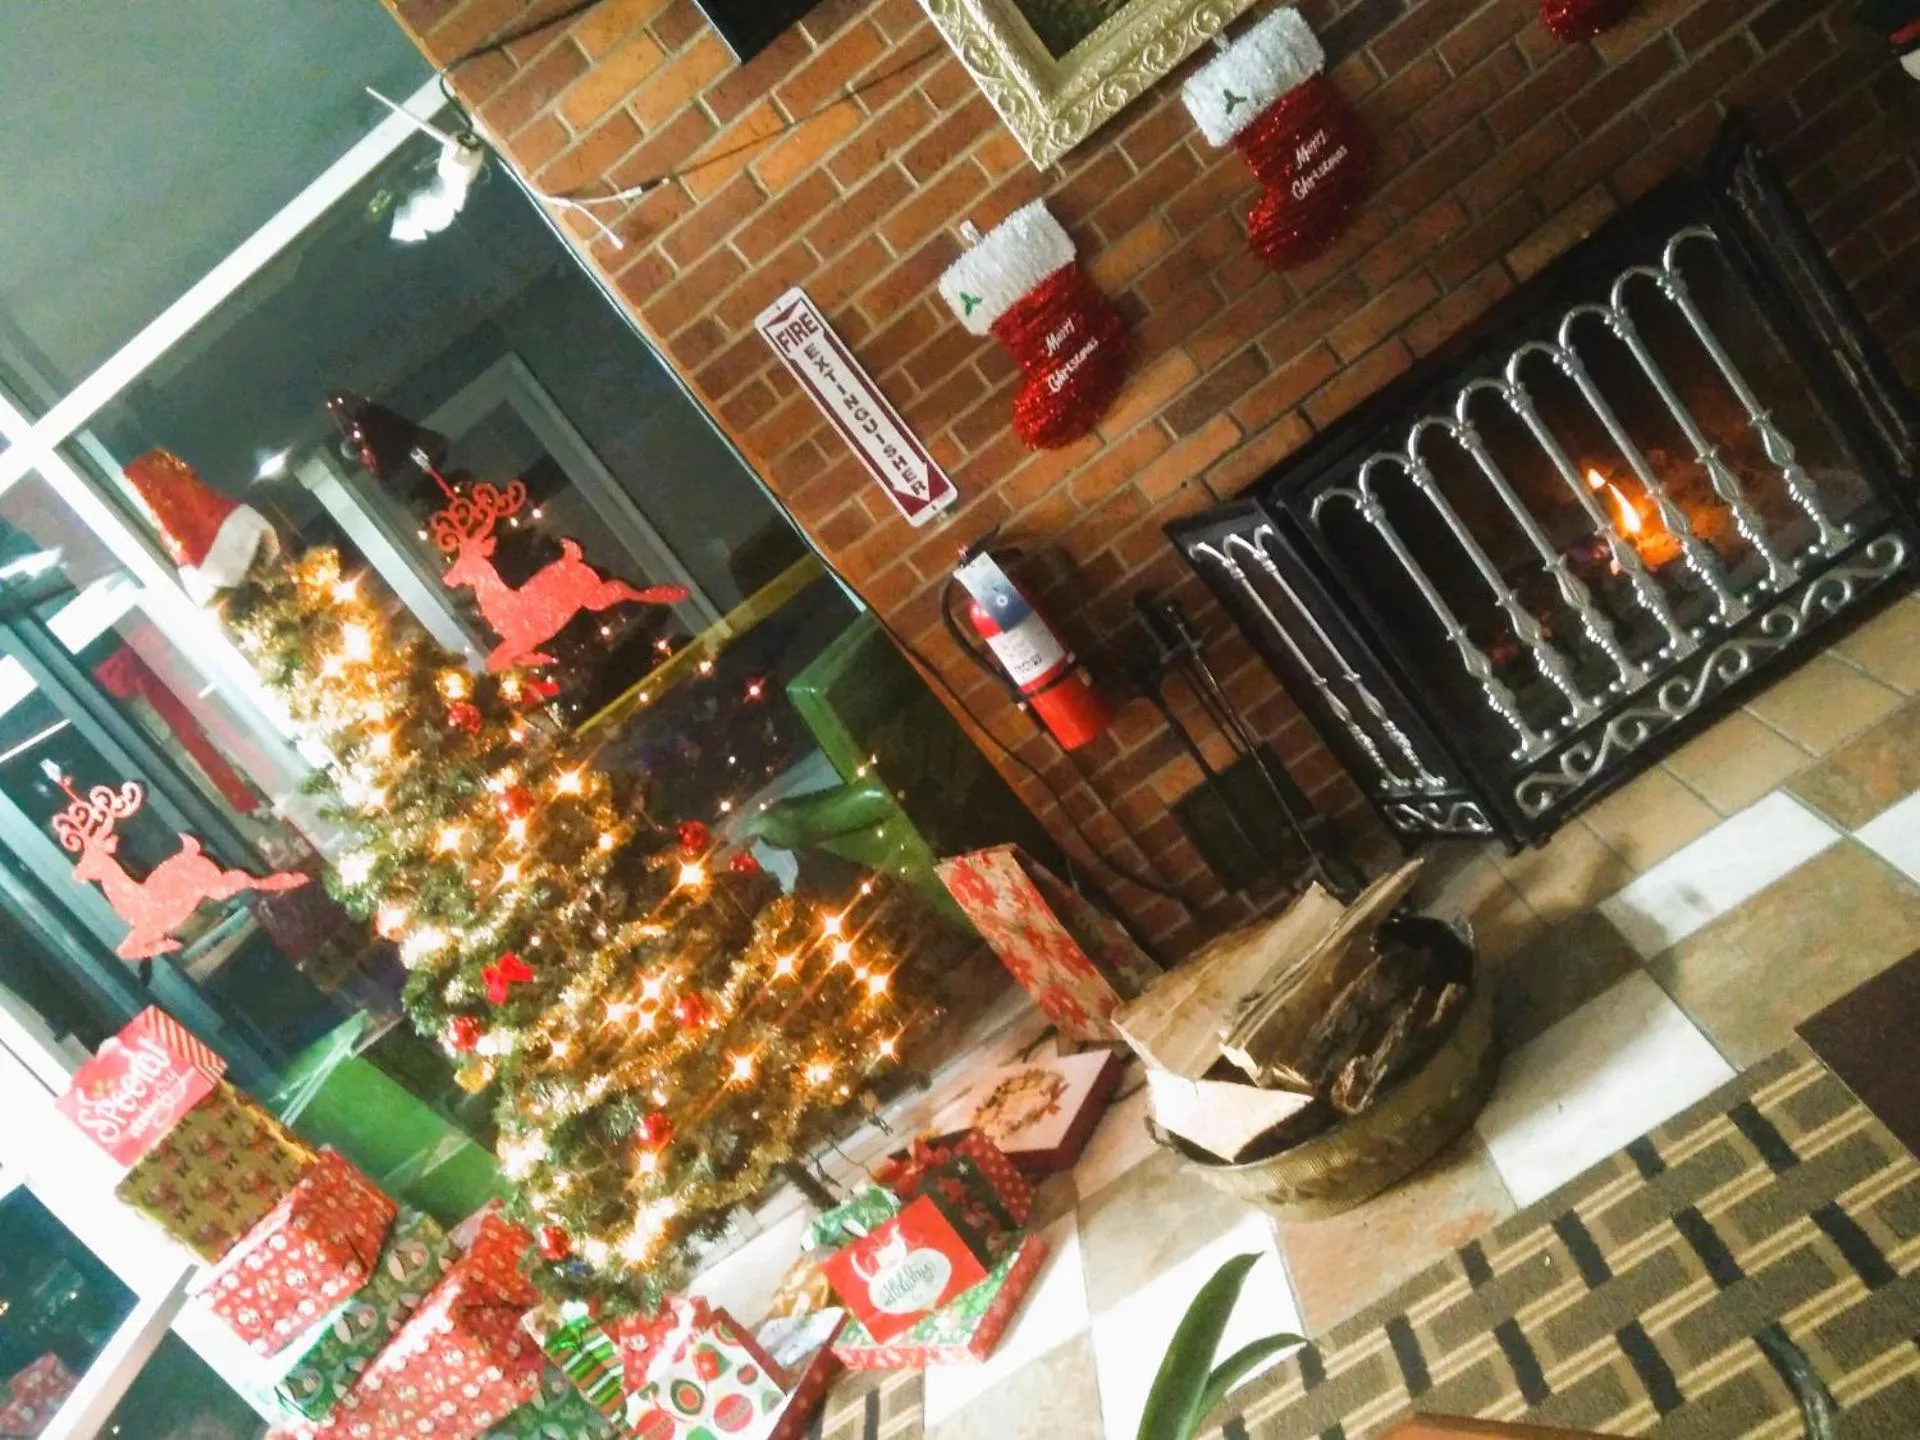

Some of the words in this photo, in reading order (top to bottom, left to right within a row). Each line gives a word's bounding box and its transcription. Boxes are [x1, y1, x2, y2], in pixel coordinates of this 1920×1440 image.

[1291, 145, 1348, 200] Christmas
[1295, 128, 1327, 170] Merry
[775, 311, 820, 353] FIRE
[1045, 317, 1076, 358] Merry
[1047, 336, 1099, 393] Christmas
[803, 342, 927, 496] EXTINGUISHER
